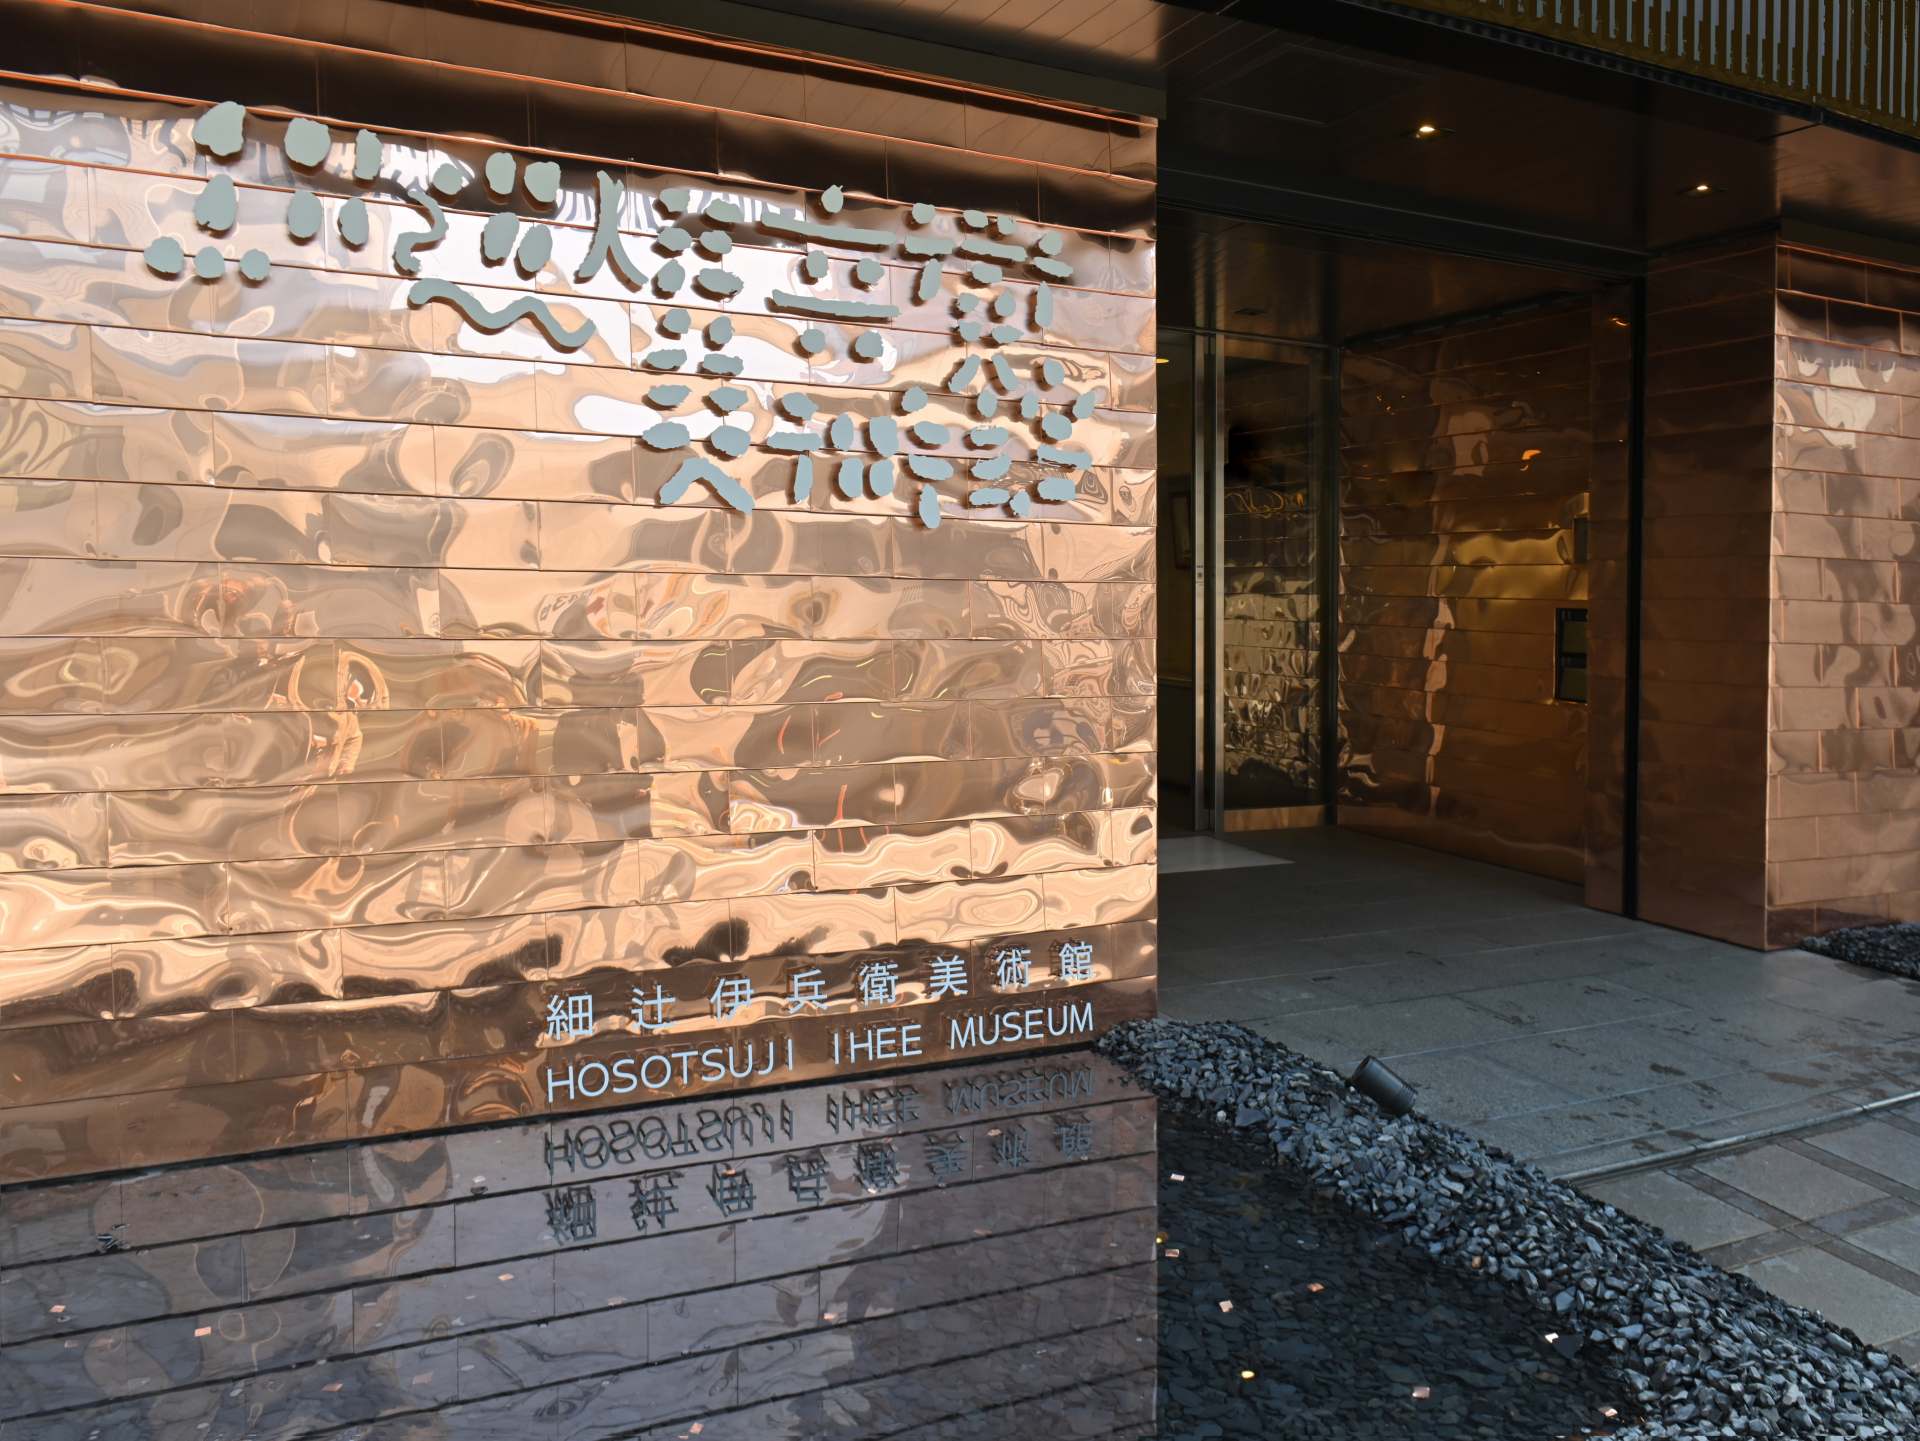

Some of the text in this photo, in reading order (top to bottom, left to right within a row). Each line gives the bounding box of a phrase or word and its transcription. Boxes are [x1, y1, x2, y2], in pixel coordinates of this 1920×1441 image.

[545, 941, 1094, 1041] 細辻伊兵衛美術館
[547, 1001, 1094, 1103] HOSOTSUJI IHEE MUSEUM
